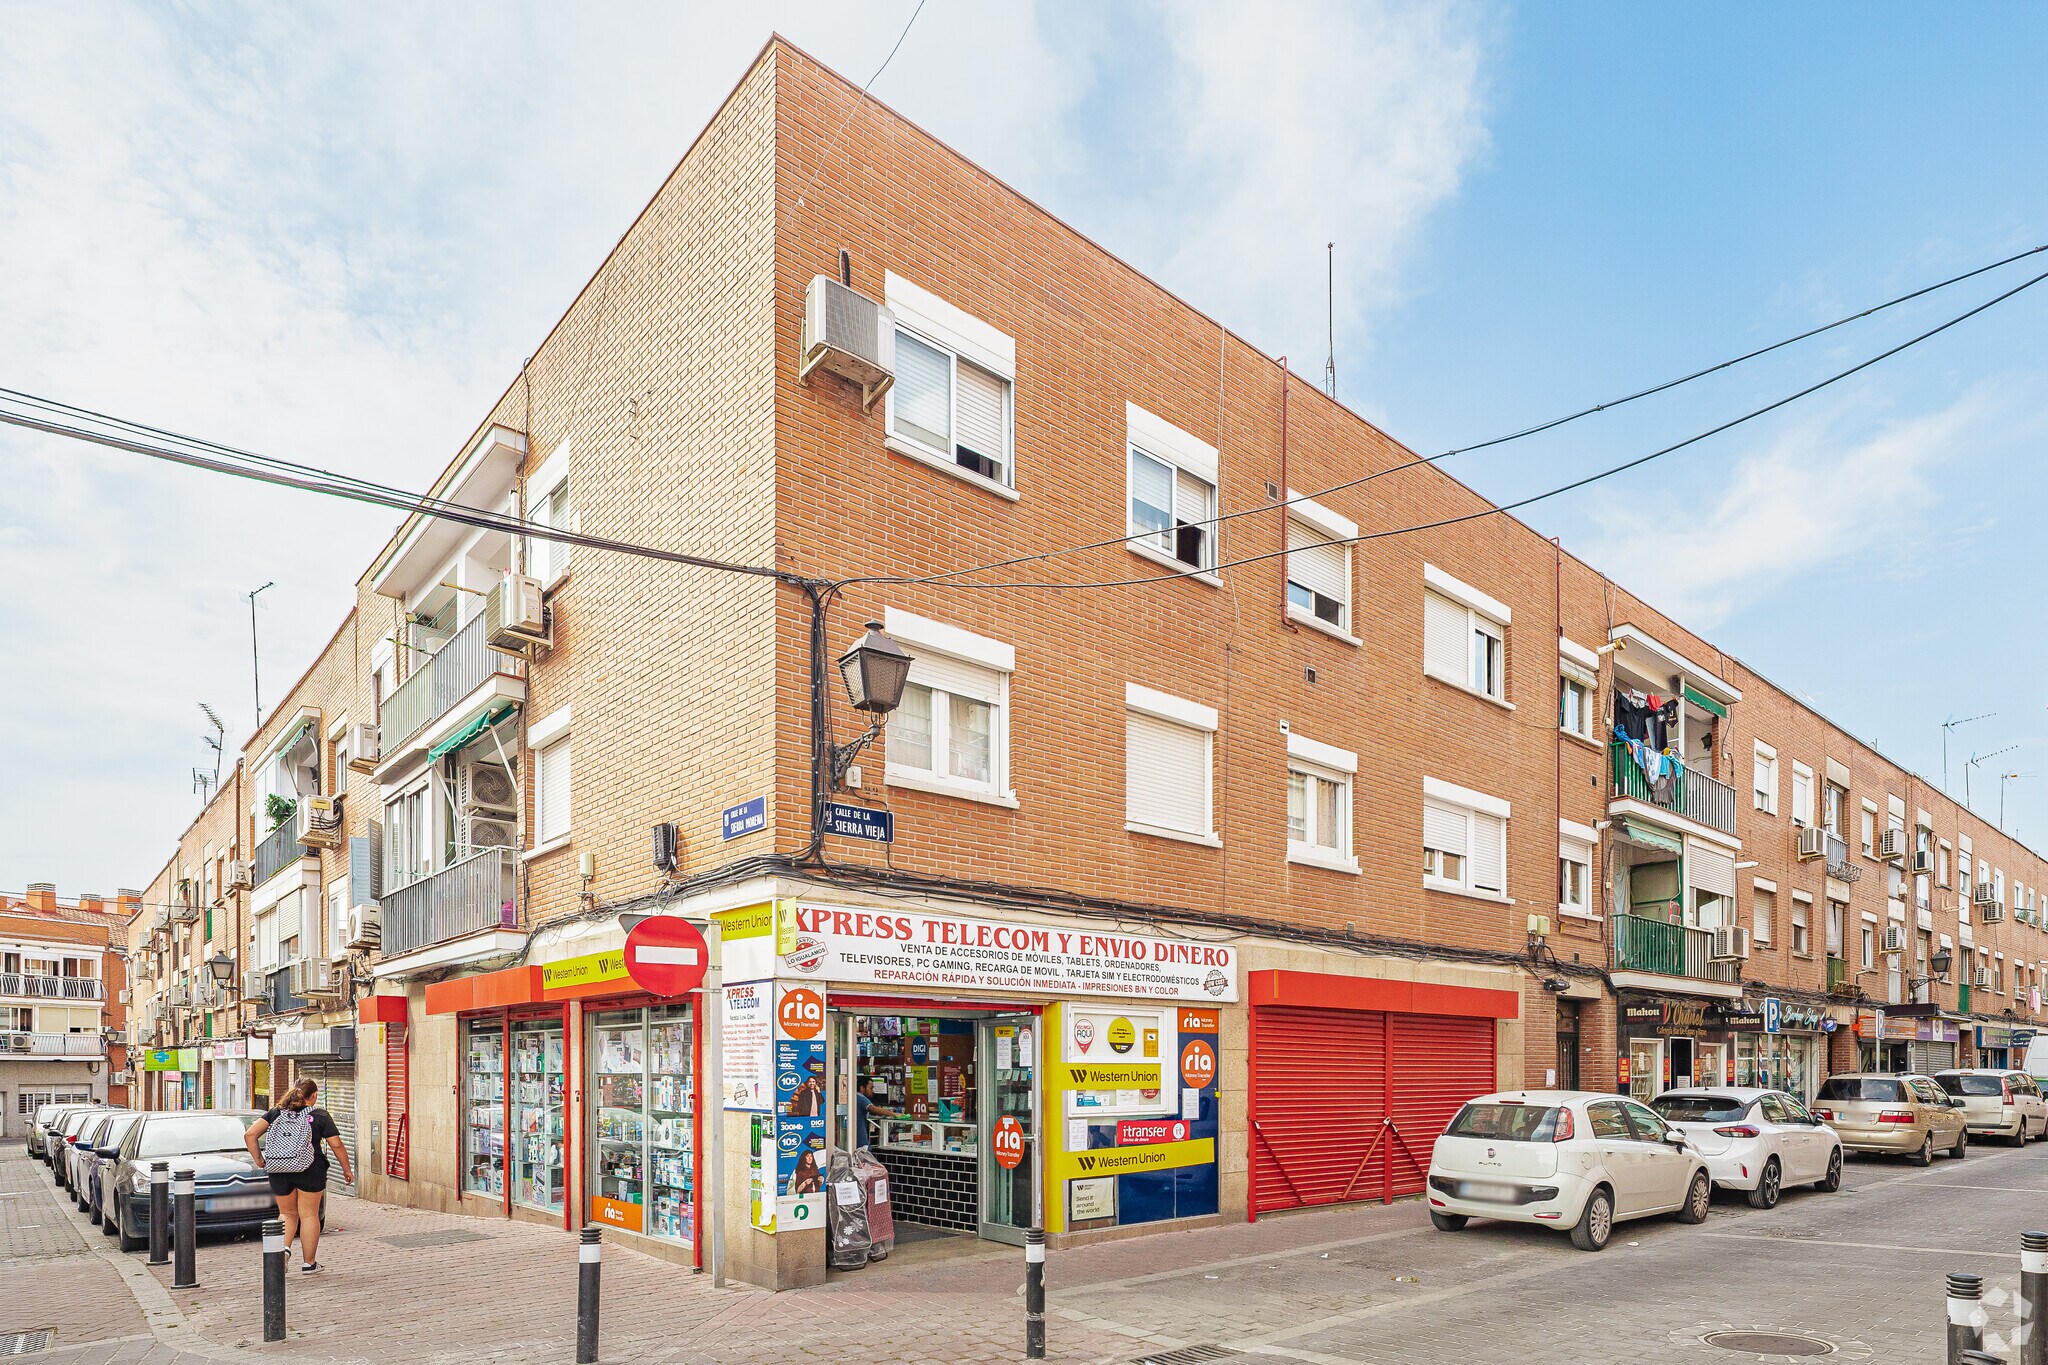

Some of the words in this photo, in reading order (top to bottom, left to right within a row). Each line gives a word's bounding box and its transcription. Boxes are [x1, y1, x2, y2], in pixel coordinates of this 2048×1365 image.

[731, 820, 744, 834] SIERRA
[746, 814, 763, 829] MORENA
[835, 808, 851, 818] CALLE
[854, 811, 861, 819] DE
[863, 812, 870, 820] LA
[835, 820, 863, 835] SIERRA
[865, 825, 885, 840] VIEJA
[922, 920, 1049, 952] TELECOM
[1057, 933, 1072, 954] Y
[1080, 935, 1146, 960] ENVIO
[1154, 943, 1229, 966] DINERO
[901, 944, 932, 954] VENTA
[935, 946, 947, 956] DE
[950, 948, 1009, 960] ACCESORIOS
[1012, 952, 1023, 962] DE
[1066, 956, 1102, 967] TABLETS,
[1104, 960, 1161, 972] ORDENADORES,
[553, 968, 572, 979] Western
[573, 965, 588, 976] Union
[840, 953, 914, 968] TELEVISORES,
[917, 959, 930, 967] PC
[933, 960, 972, 972] GAMING,
[976, 963, 1018, 974] RECARGA
[1021, 965, 1032, 974] DE
[1034, 967, 1060, 977] MOVIL
[1066, 969, 1100, 979] TARJETA
[1102, 971, 1114, 980] SIM
[1123, 972, 1199, 985] ELECTRODOMÉSTICOS
[874, 969, 939, 982] REPARACIÓN
[942, 971, 976, 984] RÁPIDA
[979, 976, 984, 984] Y
[987, 976, 1030, 986] SOLUCIÓN
[1033, 978, 1076, 989] INMEDIATA
[1082, 982, 1133, 993] IMPRESIONES
[1155, 986, 1178, 995] COLOR
[726, 987, 754, 999] XPRESS
[783, 993, 820, 1019] ria
[1627, 1007, 1660, 1016] Mahou
[1769, 1003, 1778, 1028] P
[1184, 1012, 1200, 1028] ria
[1186, 1046, 1211, 1070] ria
[1090, 1071, 1130, 1082] Western
[1131, 1071, 1158, 1082] Union
[913, 1099, 926, 1113] ria
[996, 1124, 1020, 1149] ria
[1098, 1156, 1137, 1168] Western
[1139, 1152, 1166, 1163] Union
[604, 1202, 615, 1219] ria
